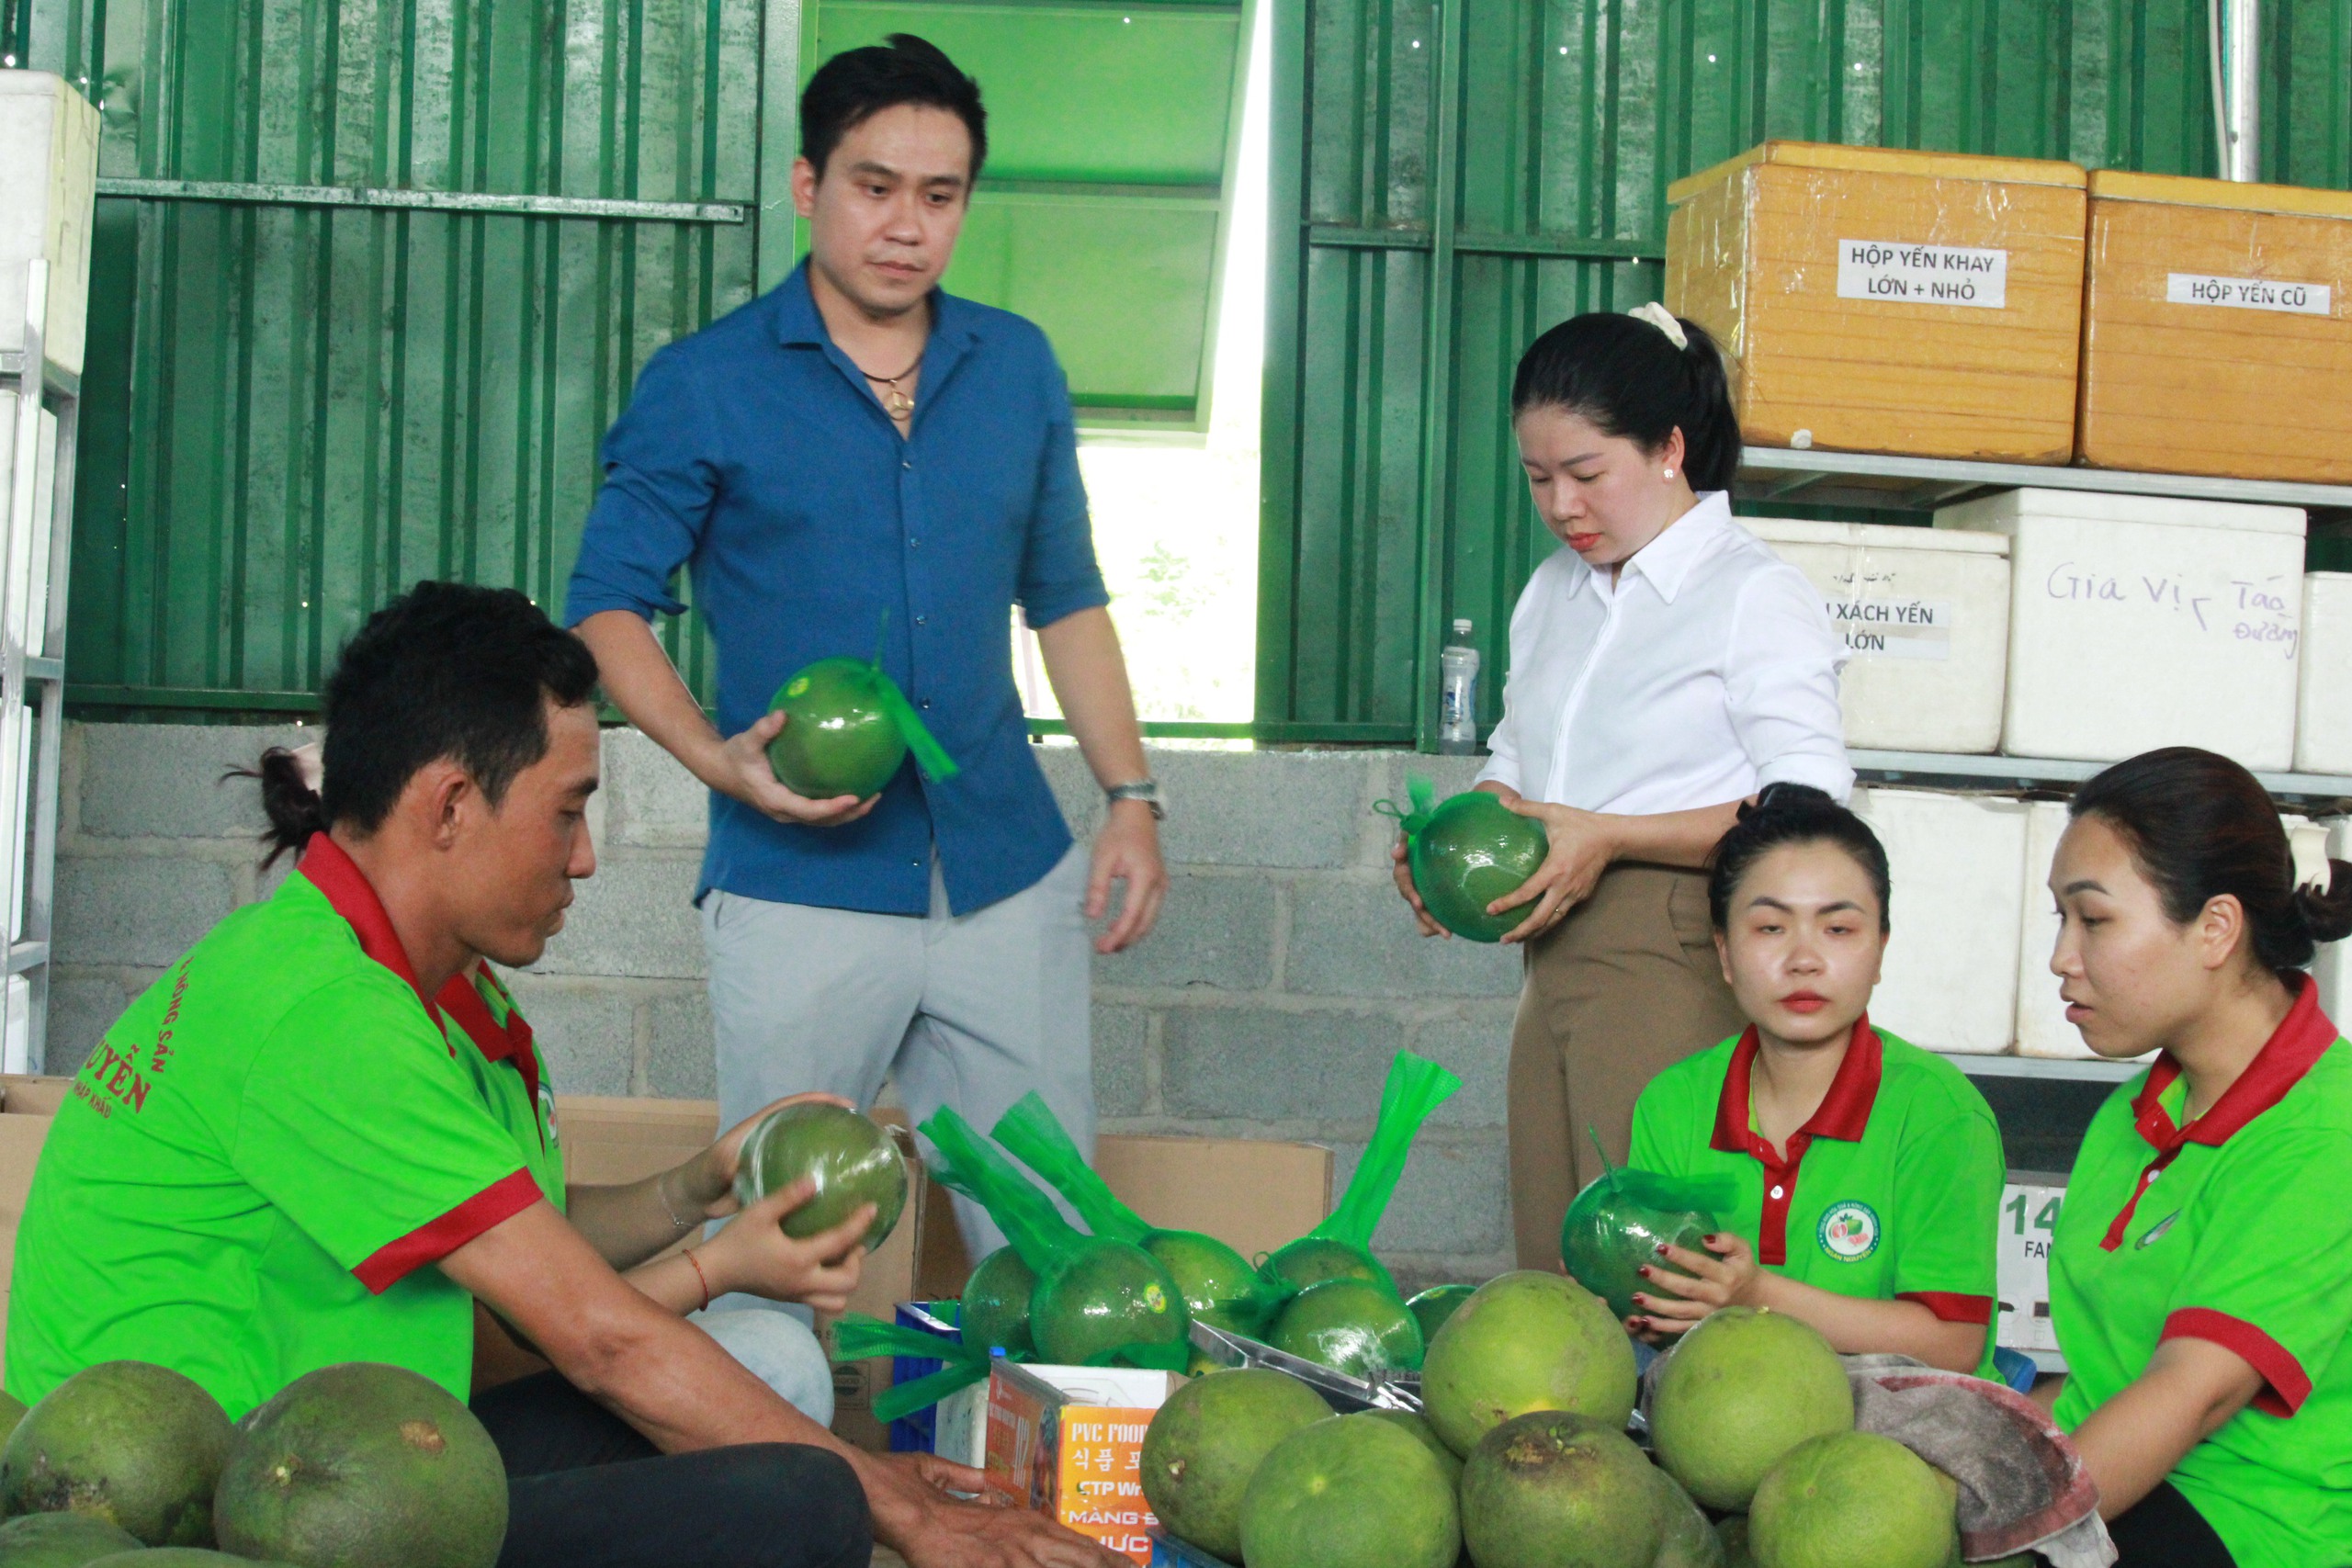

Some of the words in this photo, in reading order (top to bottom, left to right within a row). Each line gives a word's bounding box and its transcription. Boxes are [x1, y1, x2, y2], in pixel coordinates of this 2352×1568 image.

[1851, 244, 1894, 268] HỘP
[1900, 245, 1937, 269] YẾN
[1943, 254, 1994, 273] KHAY
[1868, 274, 1907, 296] LỚN
[1914, 284, 1925, 296] +
[1931, 277, 1975, 299] NHỎ
[2192, 279, 2233, 303] HỘP
[2238, 280, 2275, 304] YẾN
[2281, 287, 2306, 306] CŨ
[2047, 561, 2127, 601] Gia
[1836, 600, 1889, 622] XÁCH
[1895, 600, 1933, 625] YẾN
[1845, 629, 1884, 651] LỚN
[151, 1030, 175, 1073] SẢN
[1071, 1423, 1102, 1442] PVC
[1117, 1481, 1144, 1496] Wr
[1069, 1506, 1139, 1525] MÀNG
